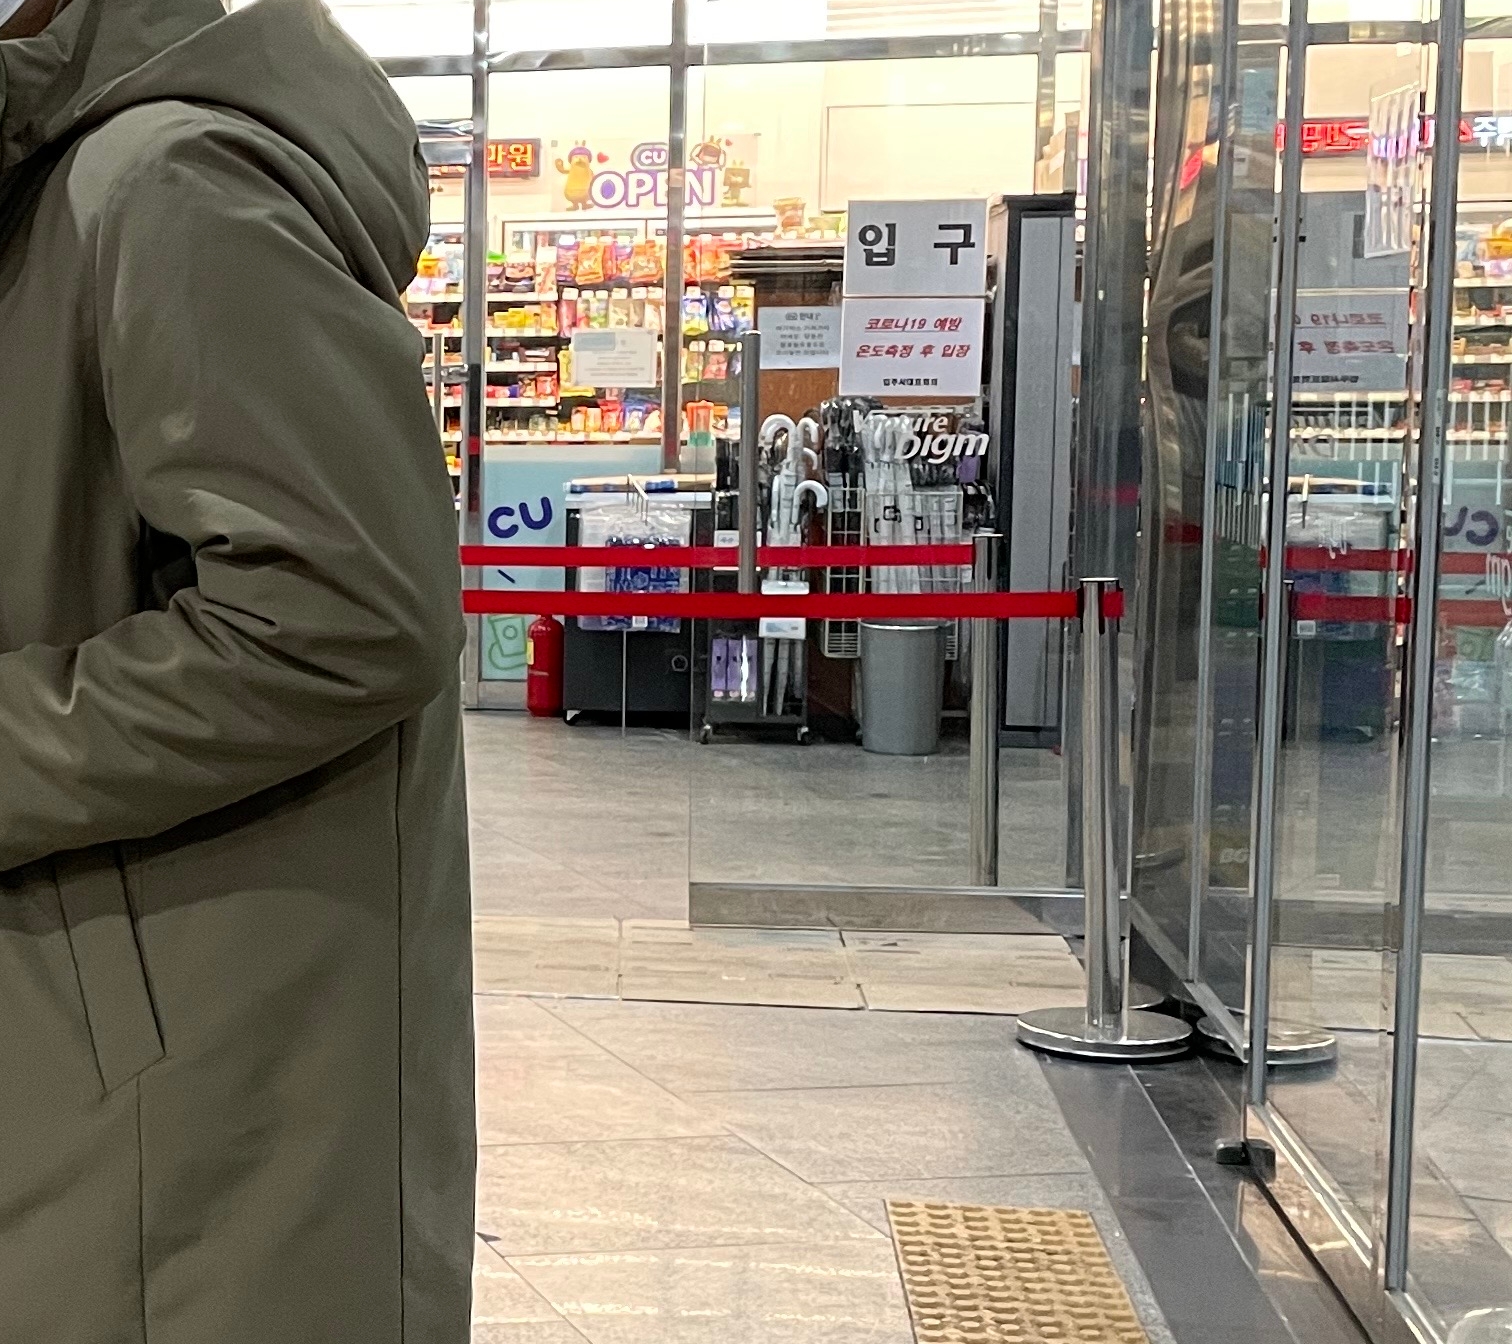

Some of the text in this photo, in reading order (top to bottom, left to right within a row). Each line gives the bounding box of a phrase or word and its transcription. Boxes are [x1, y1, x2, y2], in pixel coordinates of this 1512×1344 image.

[640, 149, 667, 164] CU
[865, 317, 962, 332] 코로나19 예방
[856, 344, 970, 358] 온도측정 후 입장
[488, 496, 553, 539] CU
